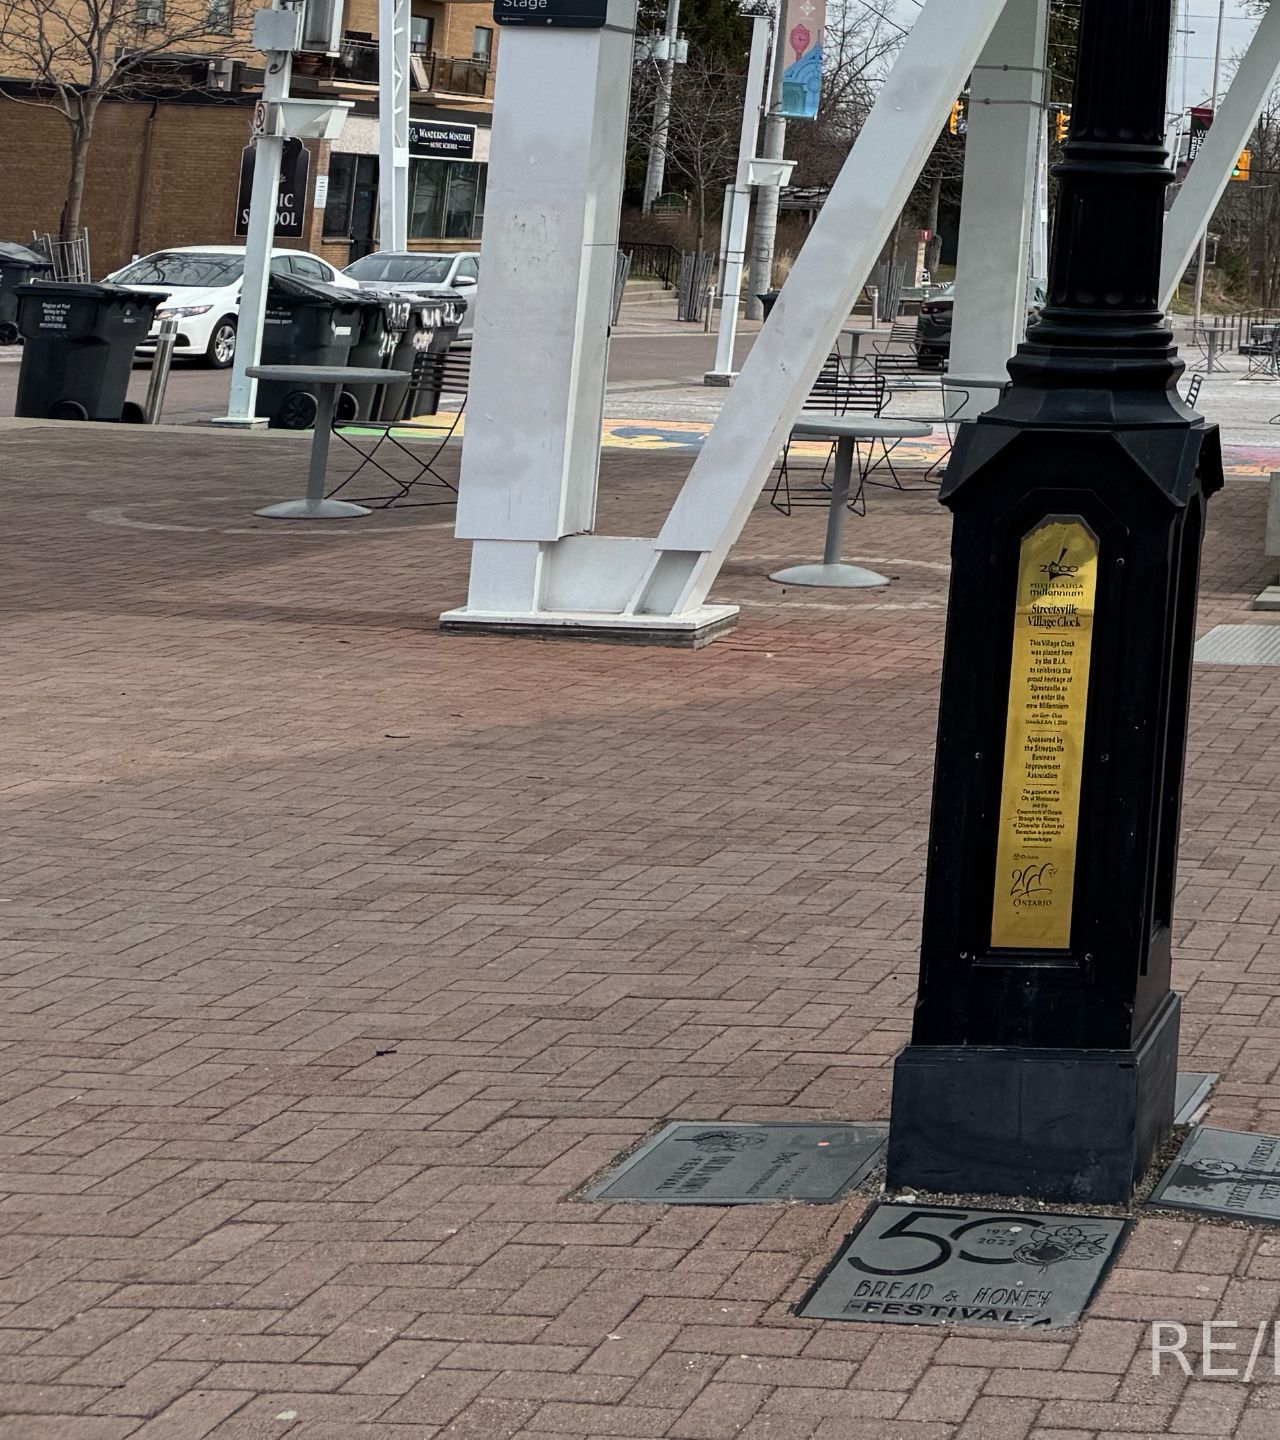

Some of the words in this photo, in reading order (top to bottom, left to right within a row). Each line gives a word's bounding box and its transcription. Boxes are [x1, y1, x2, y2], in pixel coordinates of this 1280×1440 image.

[1032, 604, 1078, 615] Streetsville
[1028, 616, 1056, 629] Village
[1057, 616, 1081, 627] Clock
[1042, 640, 1059, 648] Village
[1247, 1139, 1278, 1166] OVERSEAS
[854, 1279, 934, 1301] BREAD
[943, 1290, 960, 1302] &
[973, 1287, 1052, 1307] HONEY
